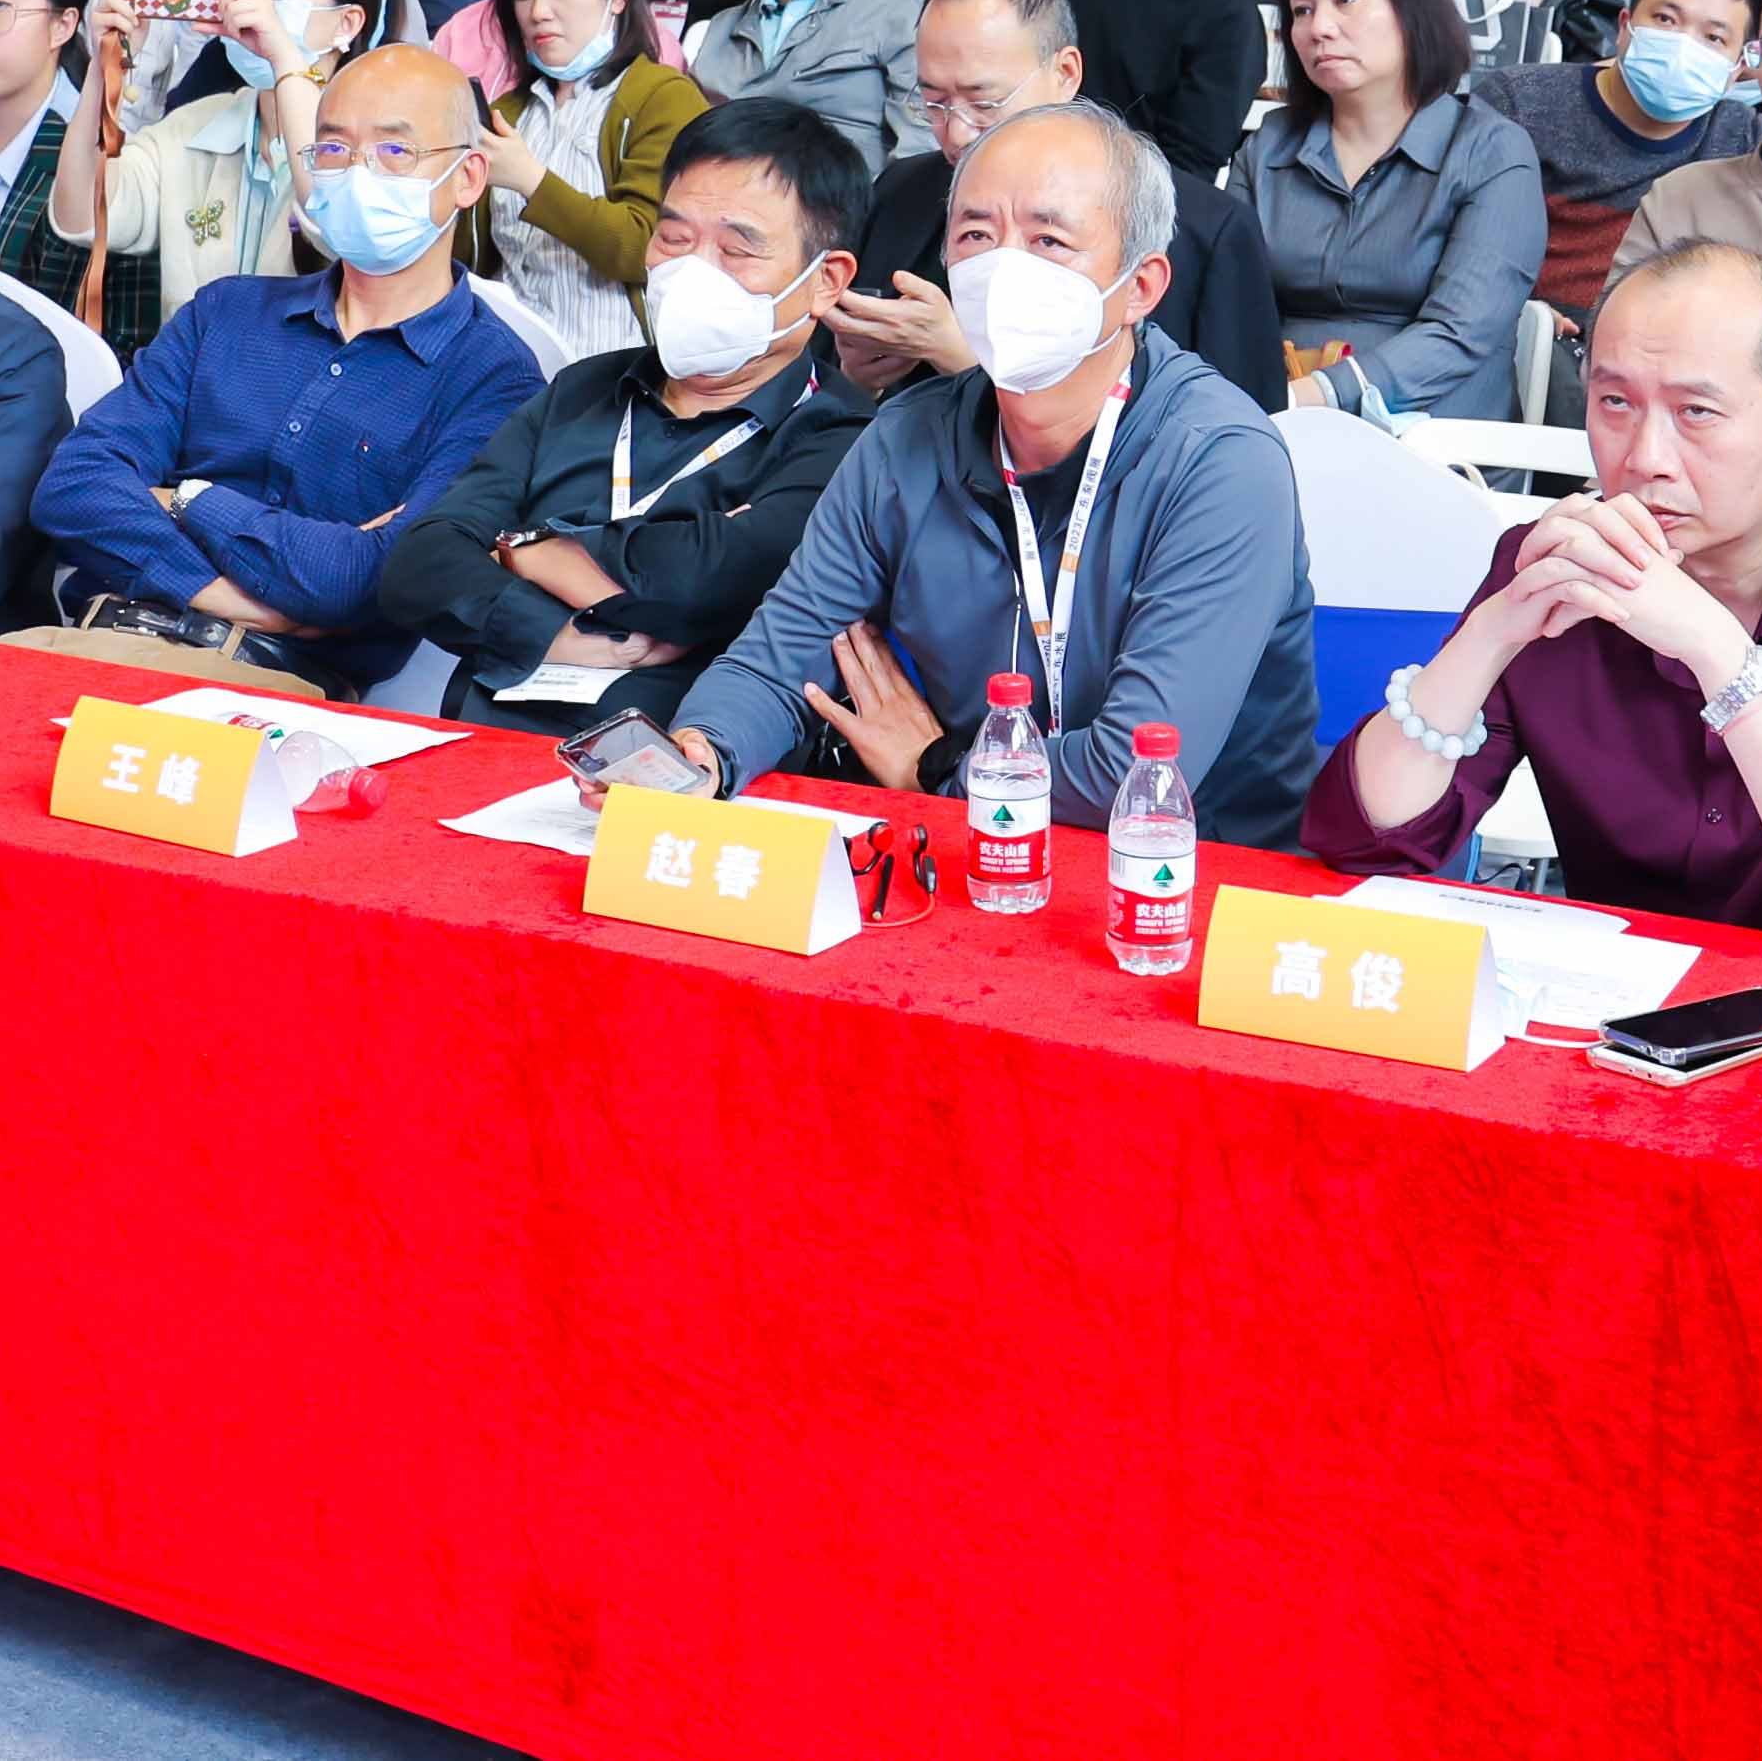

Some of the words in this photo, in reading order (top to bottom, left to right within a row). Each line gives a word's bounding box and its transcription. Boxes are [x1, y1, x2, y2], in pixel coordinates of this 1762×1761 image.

[101, 743, 201, 807] 王峰
[644, 832, 765, 900] 赵春
[1270, 940, 1405, 1014] 高俊
